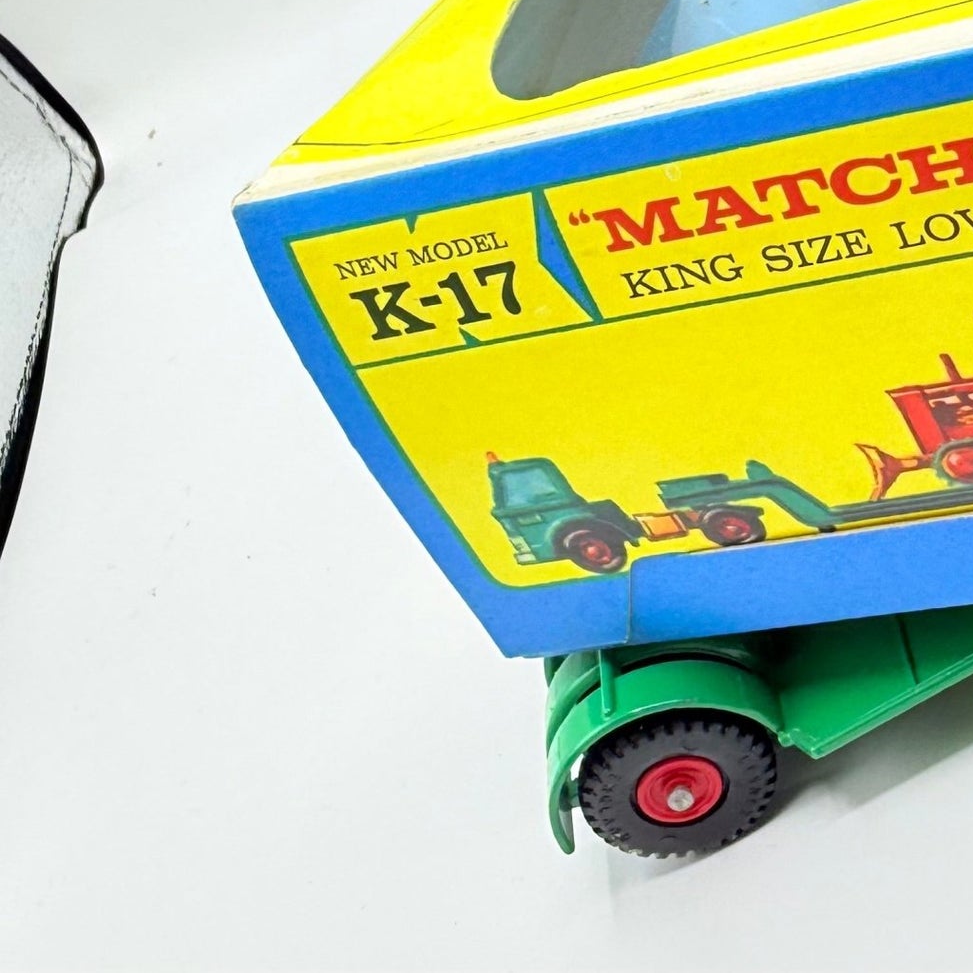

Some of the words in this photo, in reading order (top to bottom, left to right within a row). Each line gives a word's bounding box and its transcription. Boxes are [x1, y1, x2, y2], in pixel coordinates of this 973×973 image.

[333, 252, 399, 281] NEW
[406, 231, 509, 267] MODEL
[620, 253, 745, 299] KING
[761, 228, 873, 273] SIZE
[348, 260, 522, 341] K-17
